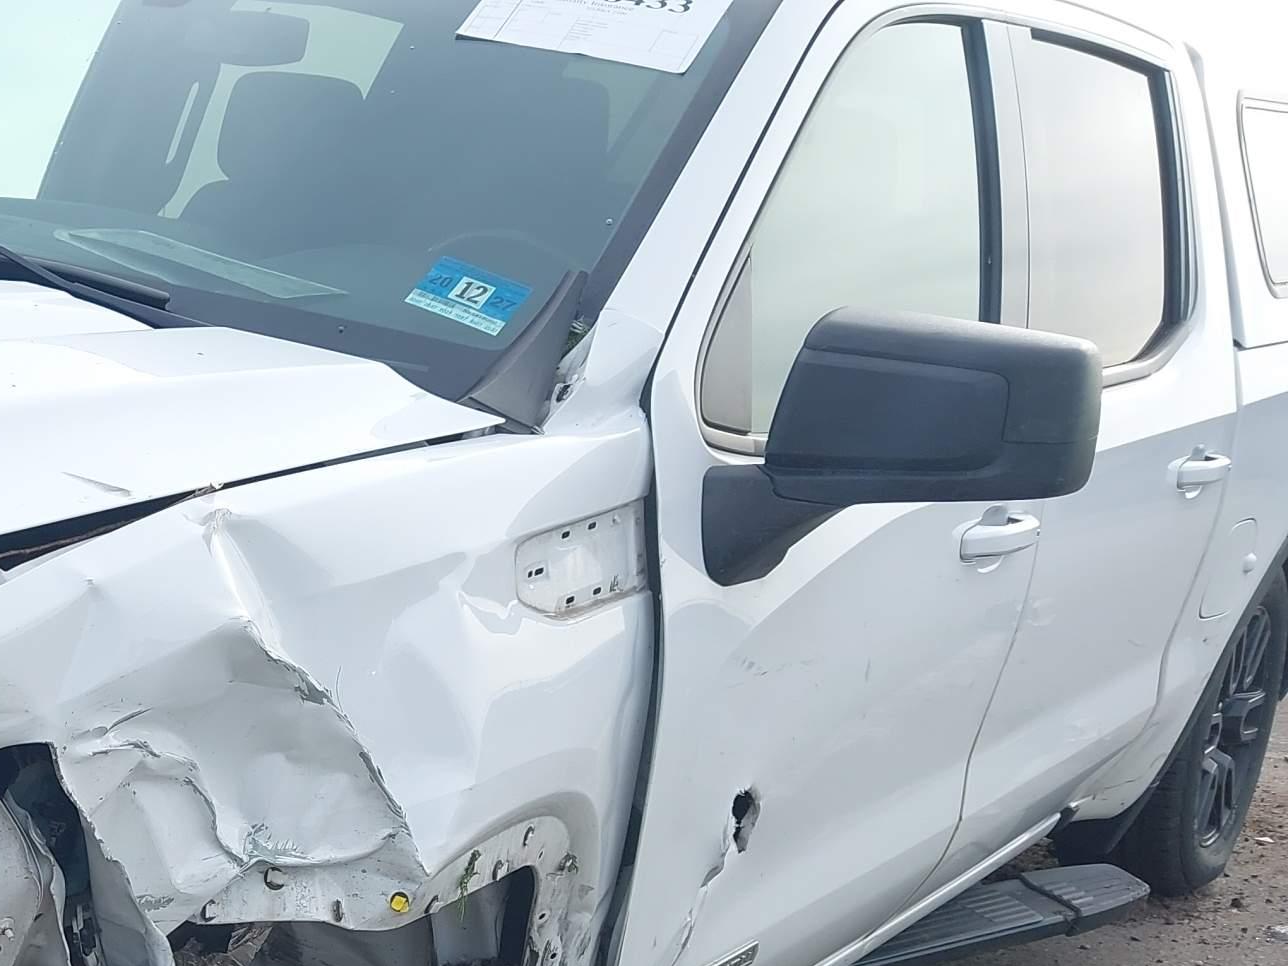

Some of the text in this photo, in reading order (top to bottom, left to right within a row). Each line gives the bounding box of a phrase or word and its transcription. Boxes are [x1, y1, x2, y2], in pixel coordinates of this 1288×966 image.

[430, 274, 453, 288] 20
[454, 281, 487, 304] 12
[489, 296, 517, 311] 27
